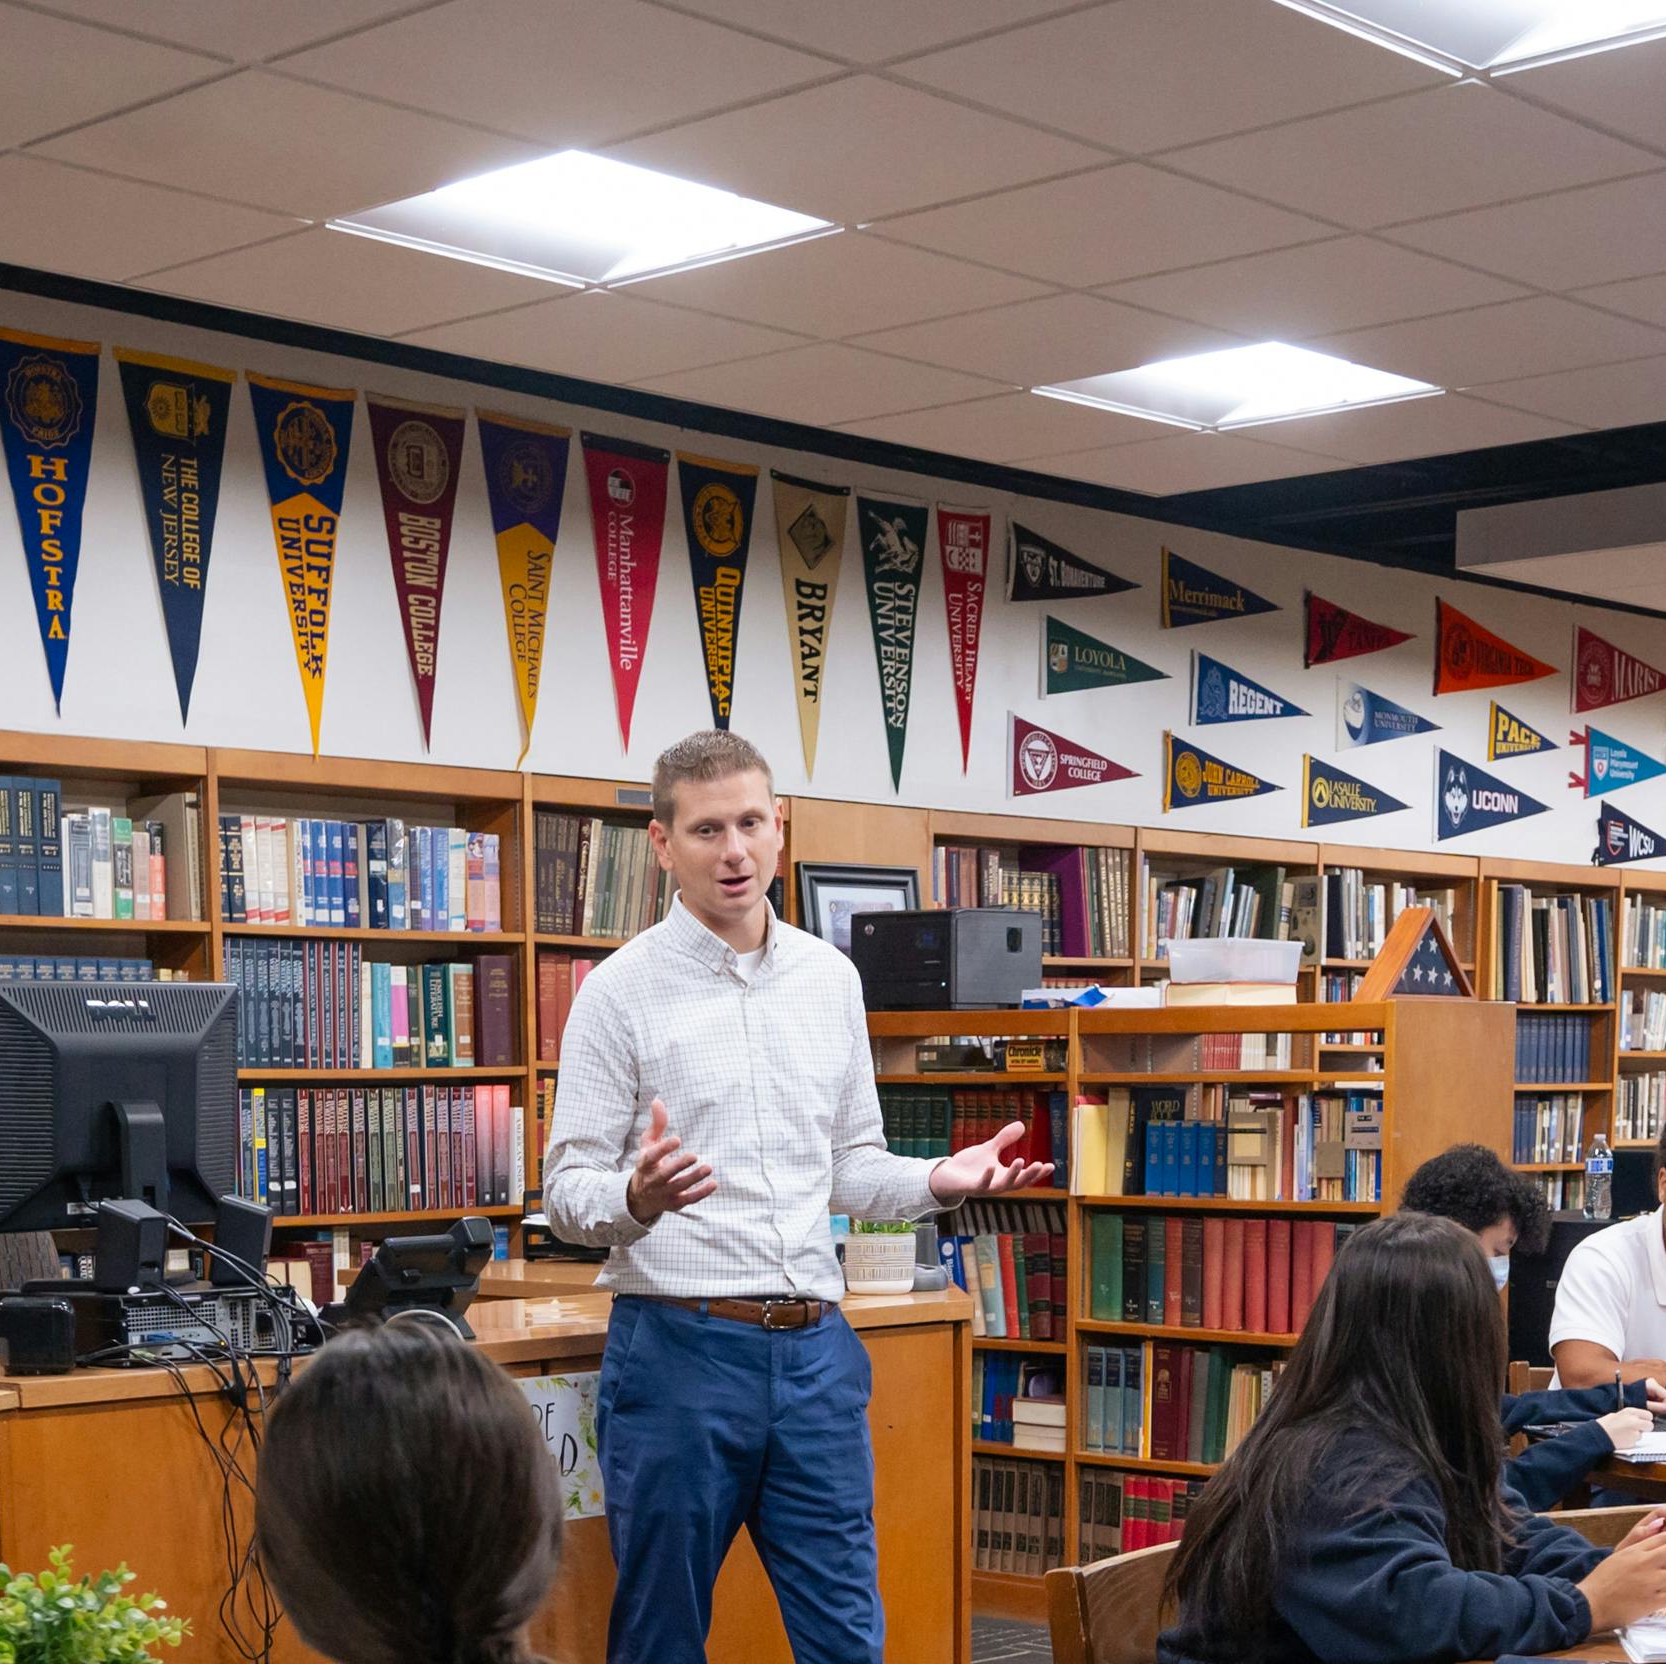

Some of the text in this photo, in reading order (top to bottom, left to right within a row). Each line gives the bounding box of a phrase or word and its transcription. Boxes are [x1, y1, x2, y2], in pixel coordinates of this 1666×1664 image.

[28, 455, 69, 639] HOFSTRA
[160, 453, 179, 586] NEW JERSEY
[180, 457, 201, 589] THE COLLEGE OF
[607, 511, 617, 581] COLLEGE
[278, 517, 311, 672] UNIVERSITY
[303, 514, 333, 680] SUFFOLK
[398, 512, 441, 677] BOSTON COLLEGE
[527, 550, 551, 606] SAINT
[618, 514, 639, 671] Manhattanville
[1048, 556, 1061, 587] ST.
[1169, 579, 1244, 611] Merrimack
[508, 584, 527, 662] COLLEGE
[699, 586, 721, 699] UNIVERSITY
[716, 566, 741, 717] QUINNIPIAC
[795, 578, 828, 703] BRYANT
[873, 581, 897, 728] UNIVERSITY
[894, 582, 916, 728] STEVENSON
[948, 593, 965, 690] UNIVERSITY
[964, 581, 982, 704] SACRED HEART
[1074, 646, 1126, 671] LOYOLA
[1611, 650, 1661, 701] MARIST
[1228, 680, 1283, 715] REGENT
[1374, 711, 1419, 725] MONMOUTH
[1496, 712, 1541, 745] PACE
[1060, 753, 1107, 771] SPRINGFIELD
[1068, 767, 1101, 782] COLLEGE
[1472, 789, 1519, 814] UCONN
[1629, 825, 1655, 857] WCSU
[436, 979, 444, 1017] ENGLISH
[1007, 1045, 1042, 1057] Chronicle
[1151, 1101, 1179, 1112] WORLD
